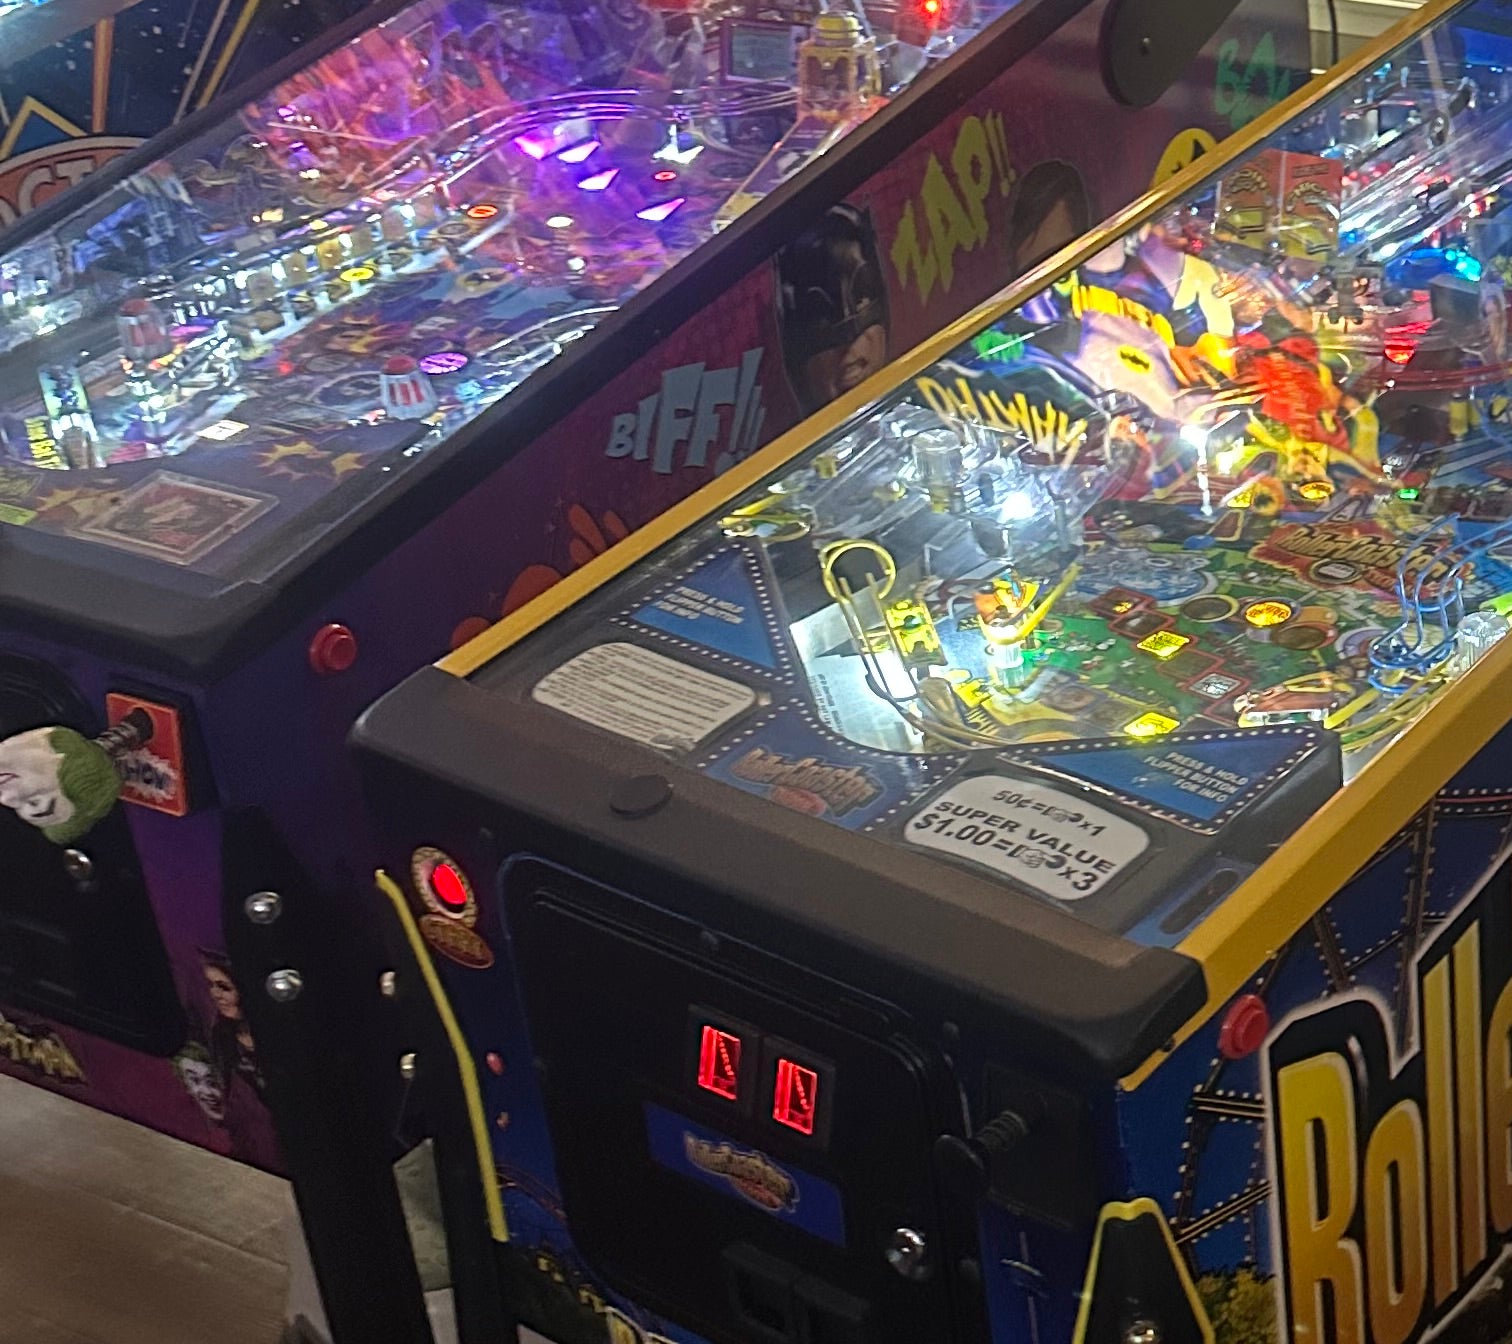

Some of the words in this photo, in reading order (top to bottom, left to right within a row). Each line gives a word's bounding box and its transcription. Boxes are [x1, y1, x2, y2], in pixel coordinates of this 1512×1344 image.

[1143, 755, 1193, 778] FLIPPER
[1189, 772, 1241, 794] BUTTON
[1167, 751, 1205, 771] PRESS
[1214, 769, 1249, 786] HOLD
[1172, 778, 1199, 793] FOR
[1199, 787, 1229, 803] INFO
[934, 800, 1022, 833] SUPER
[1027, 828, 1117, 875] VALUE
